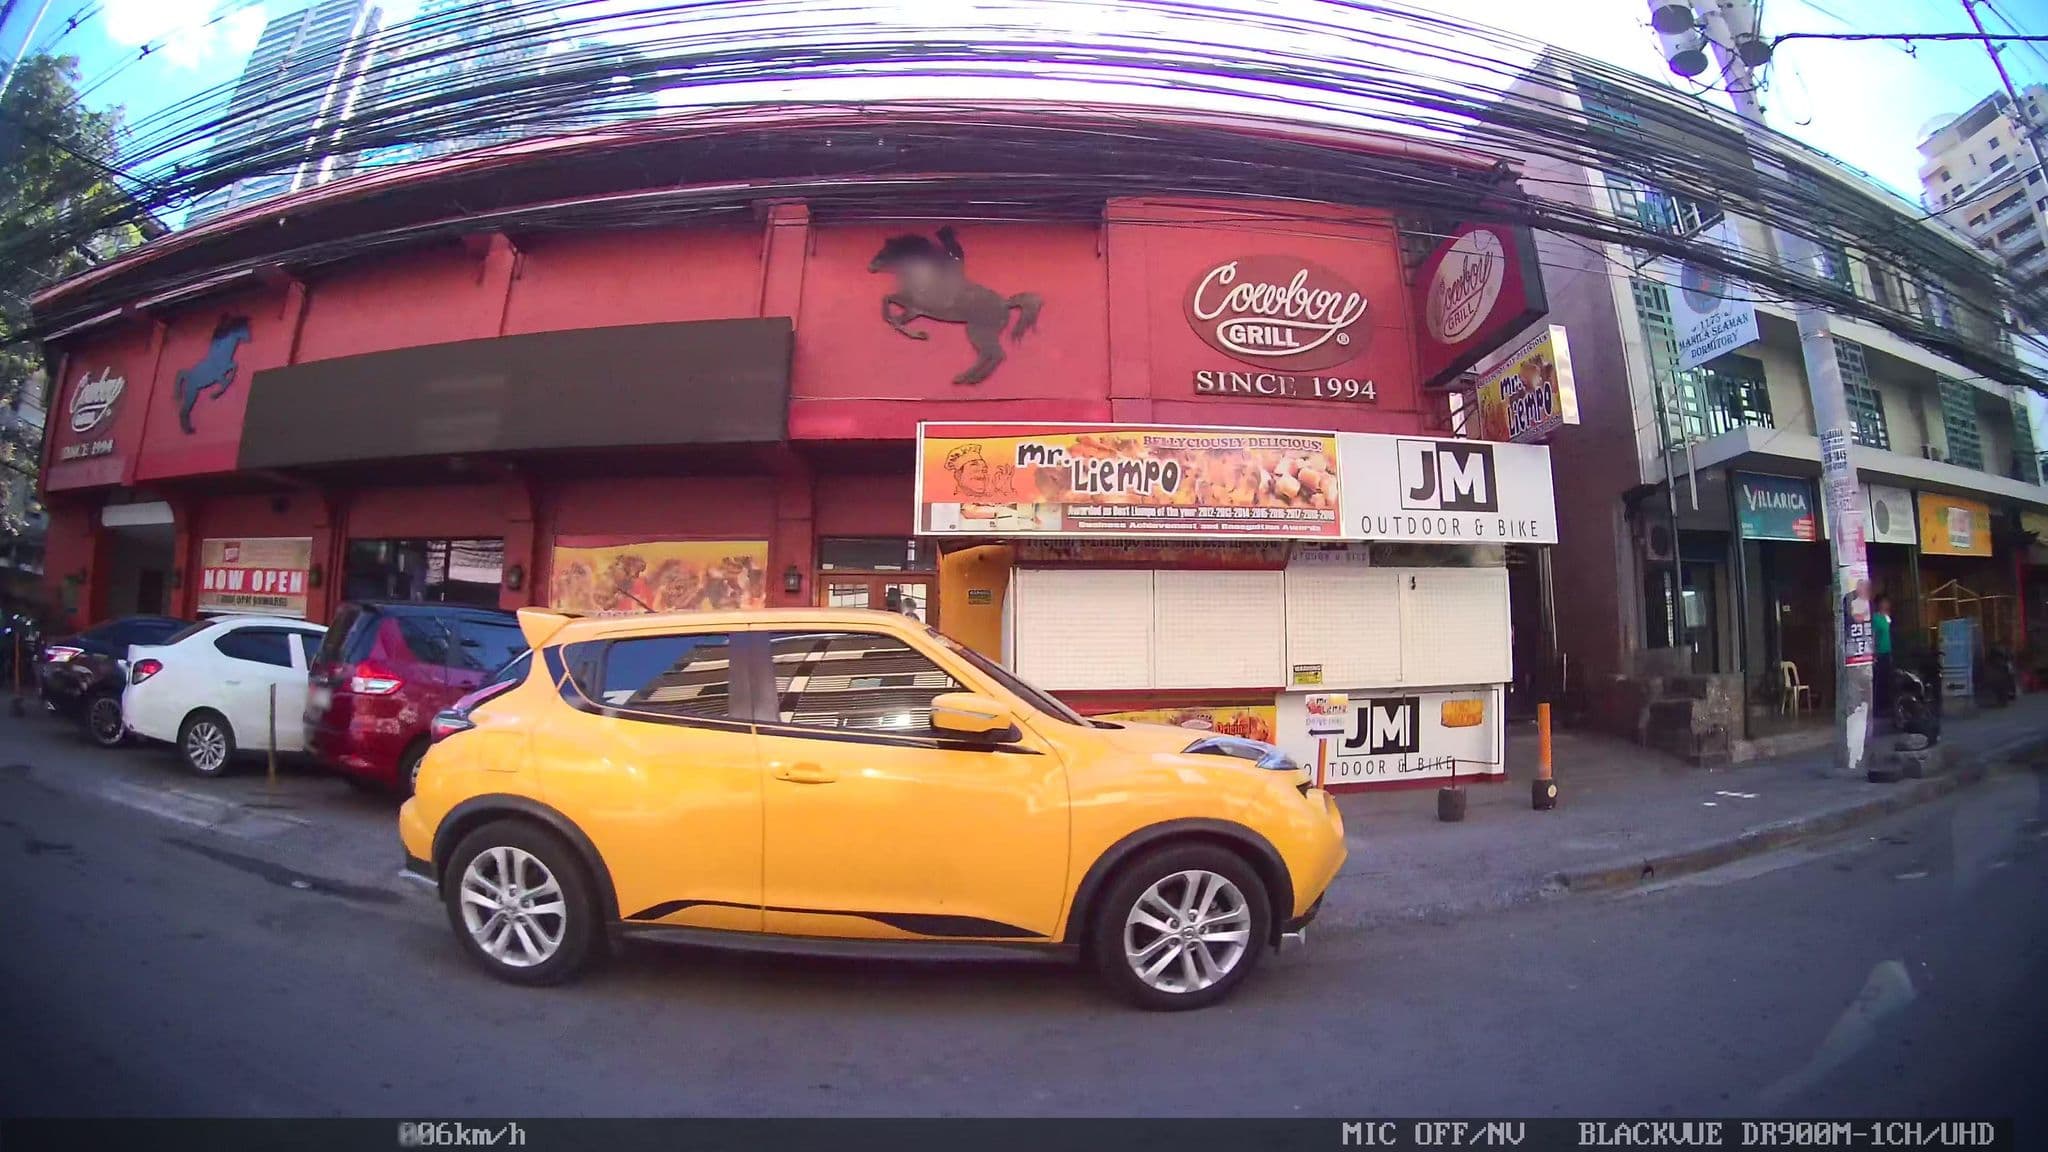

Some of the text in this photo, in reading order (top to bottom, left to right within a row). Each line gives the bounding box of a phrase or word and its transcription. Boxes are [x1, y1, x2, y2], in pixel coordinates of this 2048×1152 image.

[1194, 261, 1368, 330] Cowboy
[1448, 306, 1475, 330] GRILL
[1229, 324, 1300, 347] GRILL
[1690, 332, 1739, 358] DORMITORY
[1196, 370, 1377, 400] SINCE 1994
[1143, 435, 1323, 451] BELLYCIOUSLY DELICIOUS!
[1409, 450, 1488, 504] JM
[1743, 484, 1807, 512] VILLARICA
[1361, 515, 1538, 537] OUTDOOR & BIKE
[203, 569, 303, 592] NOW OPEN
[1344, 704, 1411, 749] JM
[1417, 755, 1452, 771] BIKE
